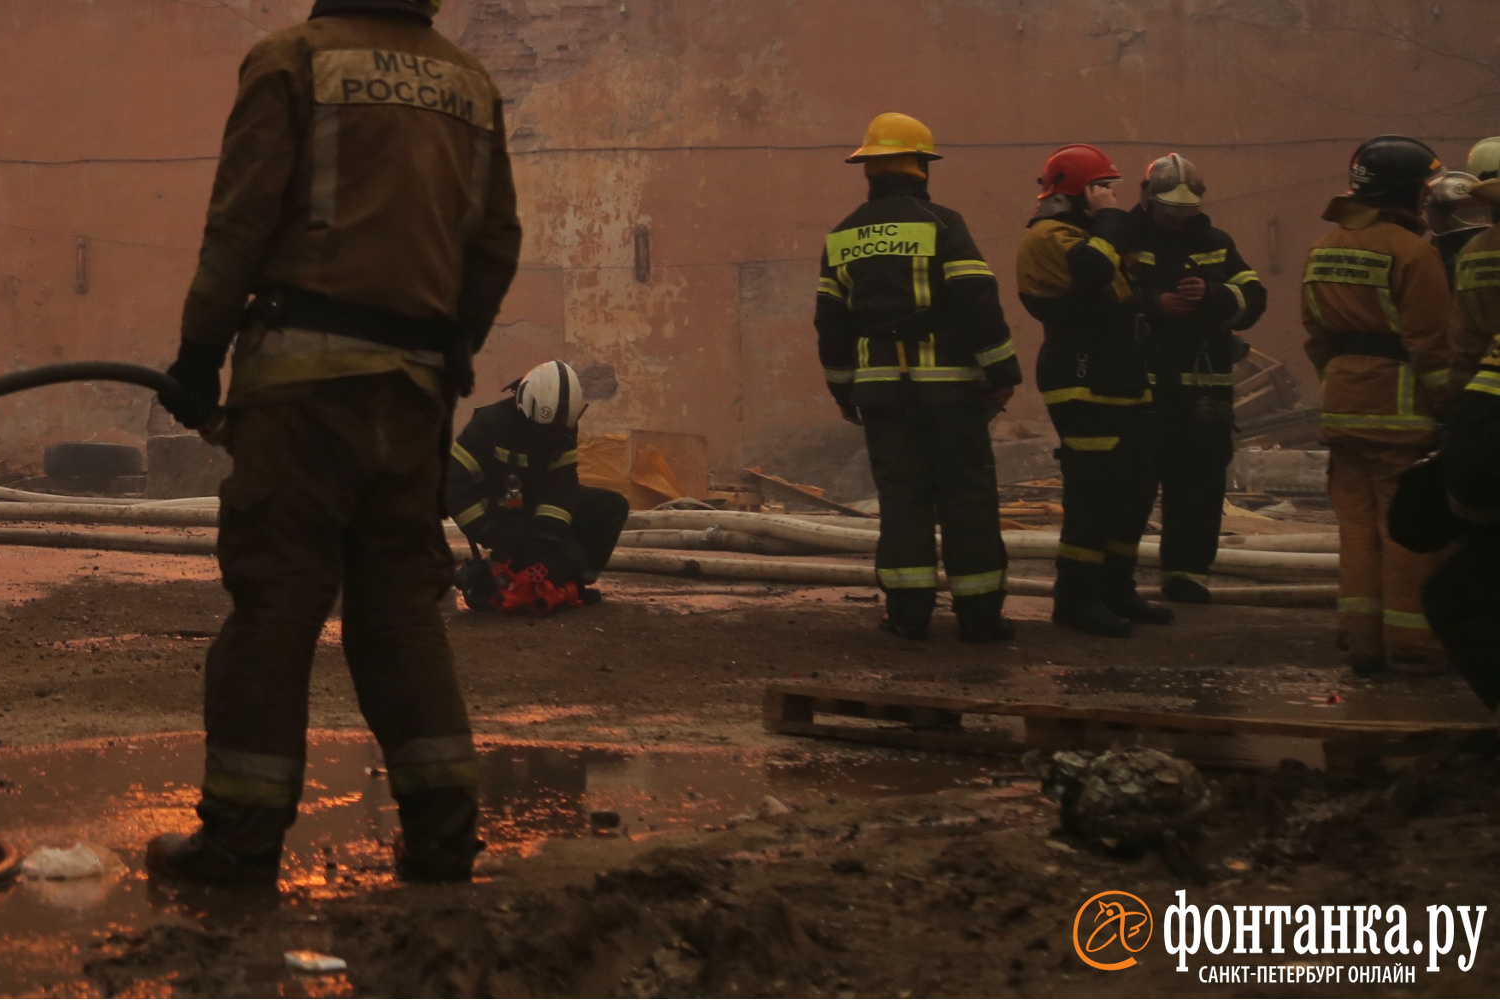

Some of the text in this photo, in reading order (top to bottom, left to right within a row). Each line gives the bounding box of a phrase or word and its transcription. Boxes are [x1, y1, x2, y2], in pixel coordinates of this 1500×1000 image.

[373, 51, 443, 80] МЧС
[342, 78, 473, 120] РОССИИ
[857, 224, 899, 240] МЧС
[841, 241, 919, 261] РОССИИ
